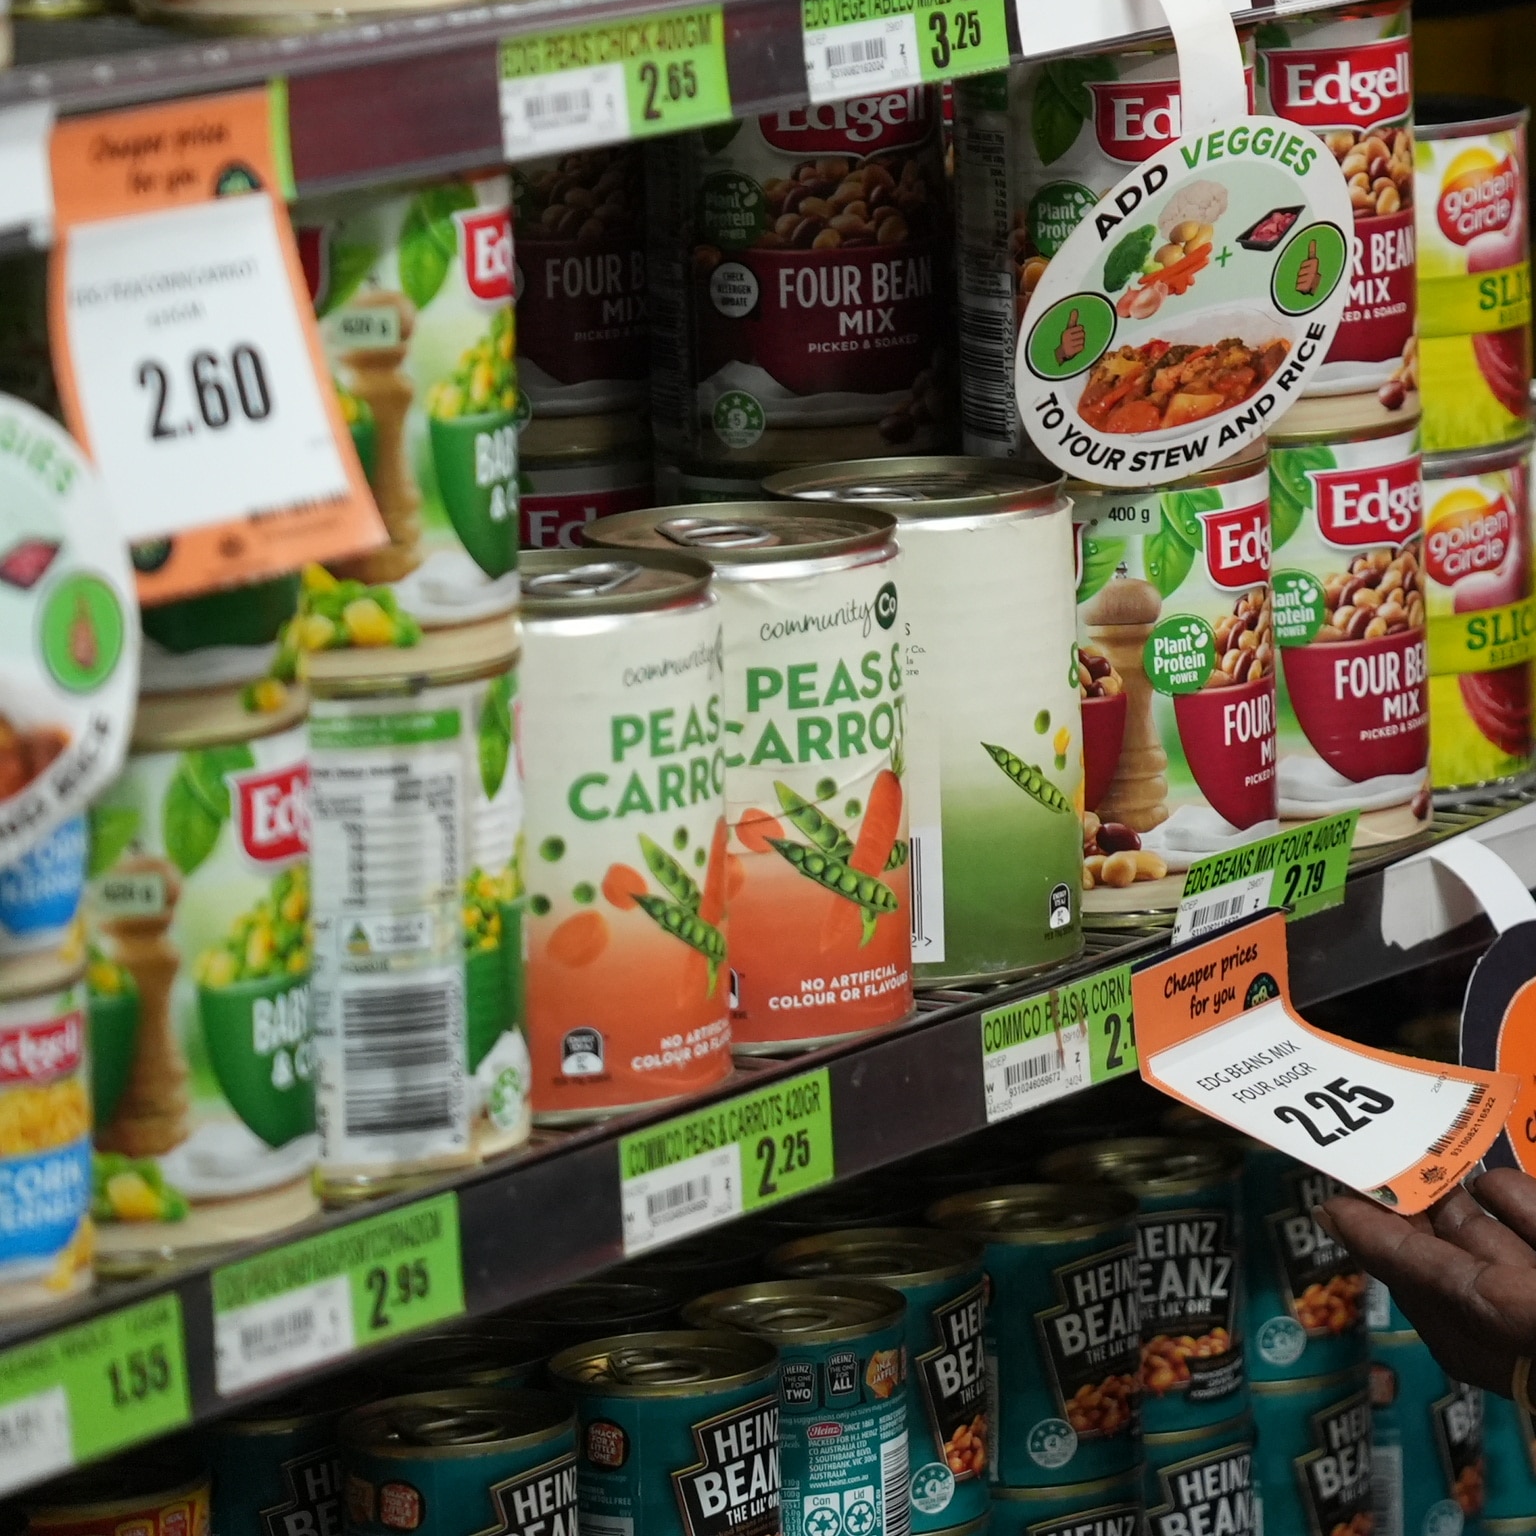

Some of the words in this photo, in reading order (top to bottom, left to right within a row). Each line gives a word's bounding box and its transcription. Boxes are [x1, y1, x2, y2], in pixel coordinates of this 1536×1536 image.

[929, 10, 981, 68] 3.25
[639, 59, 697, 121] 2.65
[1284, 52, 1410, 116] Edgell
[1094, 164, 1169, 242] ADD
[1180, 126, 1318, 177] VEGGIES
[1445, 168, 1514, 220] golden
[1038, 202, 1076, 220] Plant
[1457, 197, 1512, 234] circle
[779, 265, 862, 309] FOUR
[872, 255, 933, 305] BEAN
[1347, 276, 1391, 306] MIX
[839, 307, 896, 337] MIX
[808, 341, 859, 354] PICKED
[138, 342, 272, 442] 2.60
[1035, 392, 1064, 430] TO
[1058, 422, 1127, 471] YOUR
[1128, 435, 1209, 474] STEW
[1218, 393, 1276, 448] AND
[1277, 321, 1326, 392] RICE
[1108, 506, 1135, 522] 400
[1141, 509, 1150, 525] g
[1429, 510, 1509, 560] golden
[1444, 538, 1505, 576] circle
[760, 598, 877, 642] community
[879, 590, 897, 615] Co
[1277, 624, 1307, 638] POWER
[1154, 634, 1193, 656] Plant
[1153, 650, 1207, 675] Protein
[1170, 670, 1199, 686] POWER
[1335, 651, 1399, 700] FOUR
[746, 650, 883, 713] PEAS
[1224, 694, 1271, 746] FOUR
[1382, 689, 1420, 722] MIX
[611, 693, 720, 764] PEAS
[1360, 724, 1400, 742] PICKED
[1183, 864, 1211, 897] EDG
[1211, 849, 1255, 888] BEANS
[1253, 841, 1280, 873] MIX
[1278, 830, 1313, 865] FOUR
[1283, 859, 1326, 907] 2.79
[801, 977, 825, 993] NO
[830, 963, 897, 989] ARTIFICIAL
[1164, 964, 1217, 999] Cheaper
[1221, 942, 1259, 979] prices
[768, 992, 836, 1010] COLOUR
[840, 988, 860, 1002] OR
[983, 1005, 1041, 1052] COMMCO
[1045, 992, 1078, 1031] PEAS
[1091, 974, 1126, 1014] CORN
[1190, 993, 1208, 1020] for
[1213, 984, 1236, 1009] you
[1197, 1065, 1231, 1093] EDG
[1230, 1052, 1275, 1081] BEANS
[1269, 1039, 1302, 1063] MIX
[1232, 1078, 1273, 1105] FOUR
[1274, 1062, 1318, 1090] 400GR
[729, 1094, 783, 1143] CARROTS
[1273, 1077, 1395, 1148] 2.25
[1450, 1096, 1497, 1157] 9310082116522
[757, 1128, 811, 1198] 2.25
[786, 1364, 811, 1375] HEINZ
[832, 1354, 853, 1366] HEINZ
[786, 1388, 811, 1400] TWO
[832, 1379, 853, 1391] ALL
[808, 1438, 835, 1448] PACKED
[836, 1436, 850, 1446] FOR
[809, 1424, 840, 1438] Heinz
[844, 1422, 861, 1432] SINCE
[815, 1452, 856, 1464] SOUTHBANK
[819, 1442, 856, 1455] AUSTRALIA
[856, 1440, 867, 1449] LTD
[809, 1470, 847, 1481] AUSTRALIA
[809, 1474, 869, 1489] www.heinz.com.au
[812, 1496, 831, 1506] Can
[853, 1490, 865, 1500] Lid
[726, 1506, 750, 1528] THE
